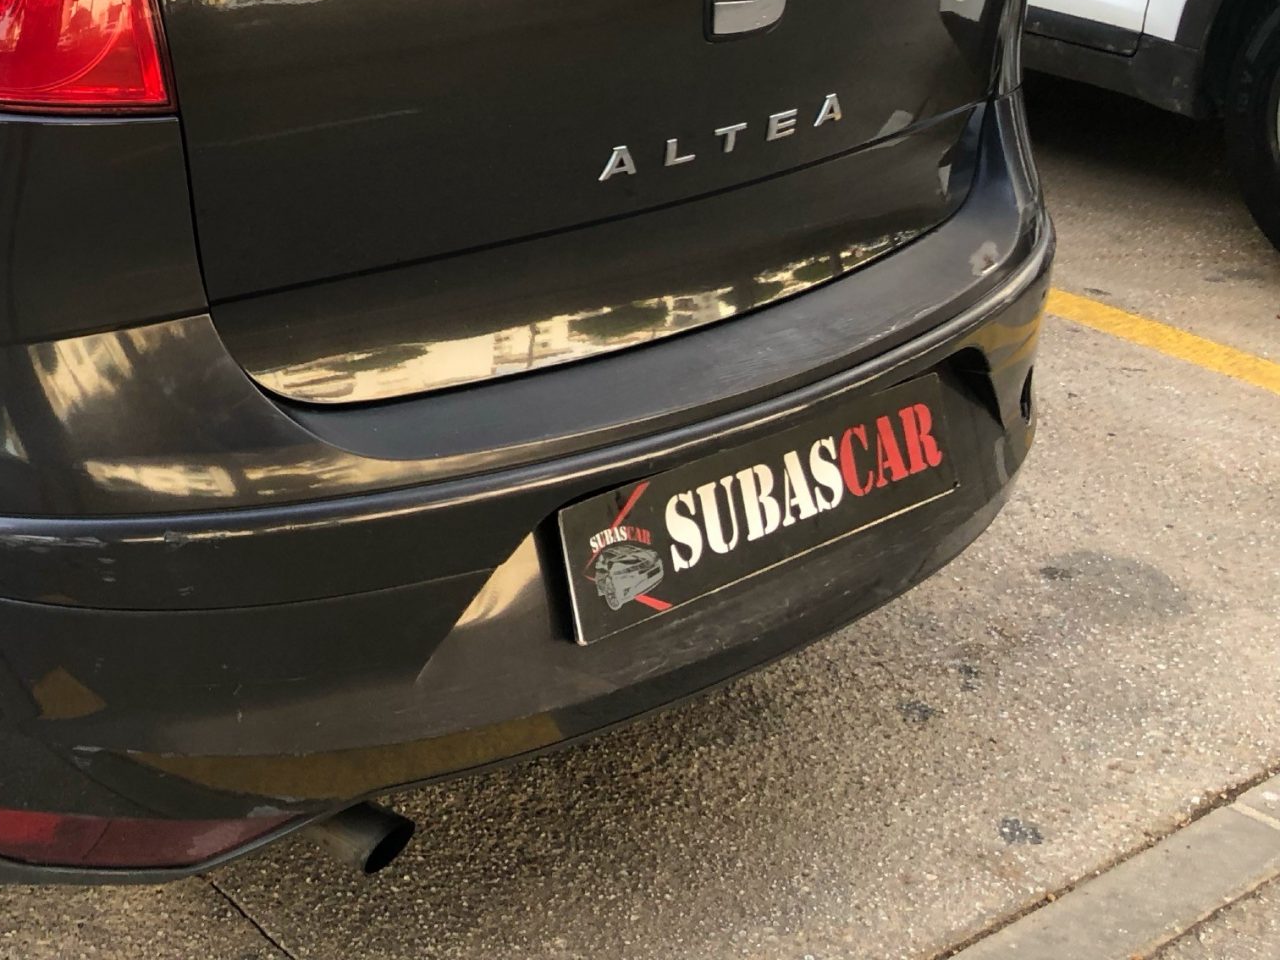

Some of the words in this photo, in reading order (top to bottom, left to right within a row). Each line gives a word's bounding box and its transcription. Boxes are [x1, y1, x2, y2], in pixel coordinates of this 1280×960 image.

[598, 93, 842, 181] ALTEA
[664, 402, 942, 573] SUBASCAR
[589, 525, 652, 554] SUBASCAR
